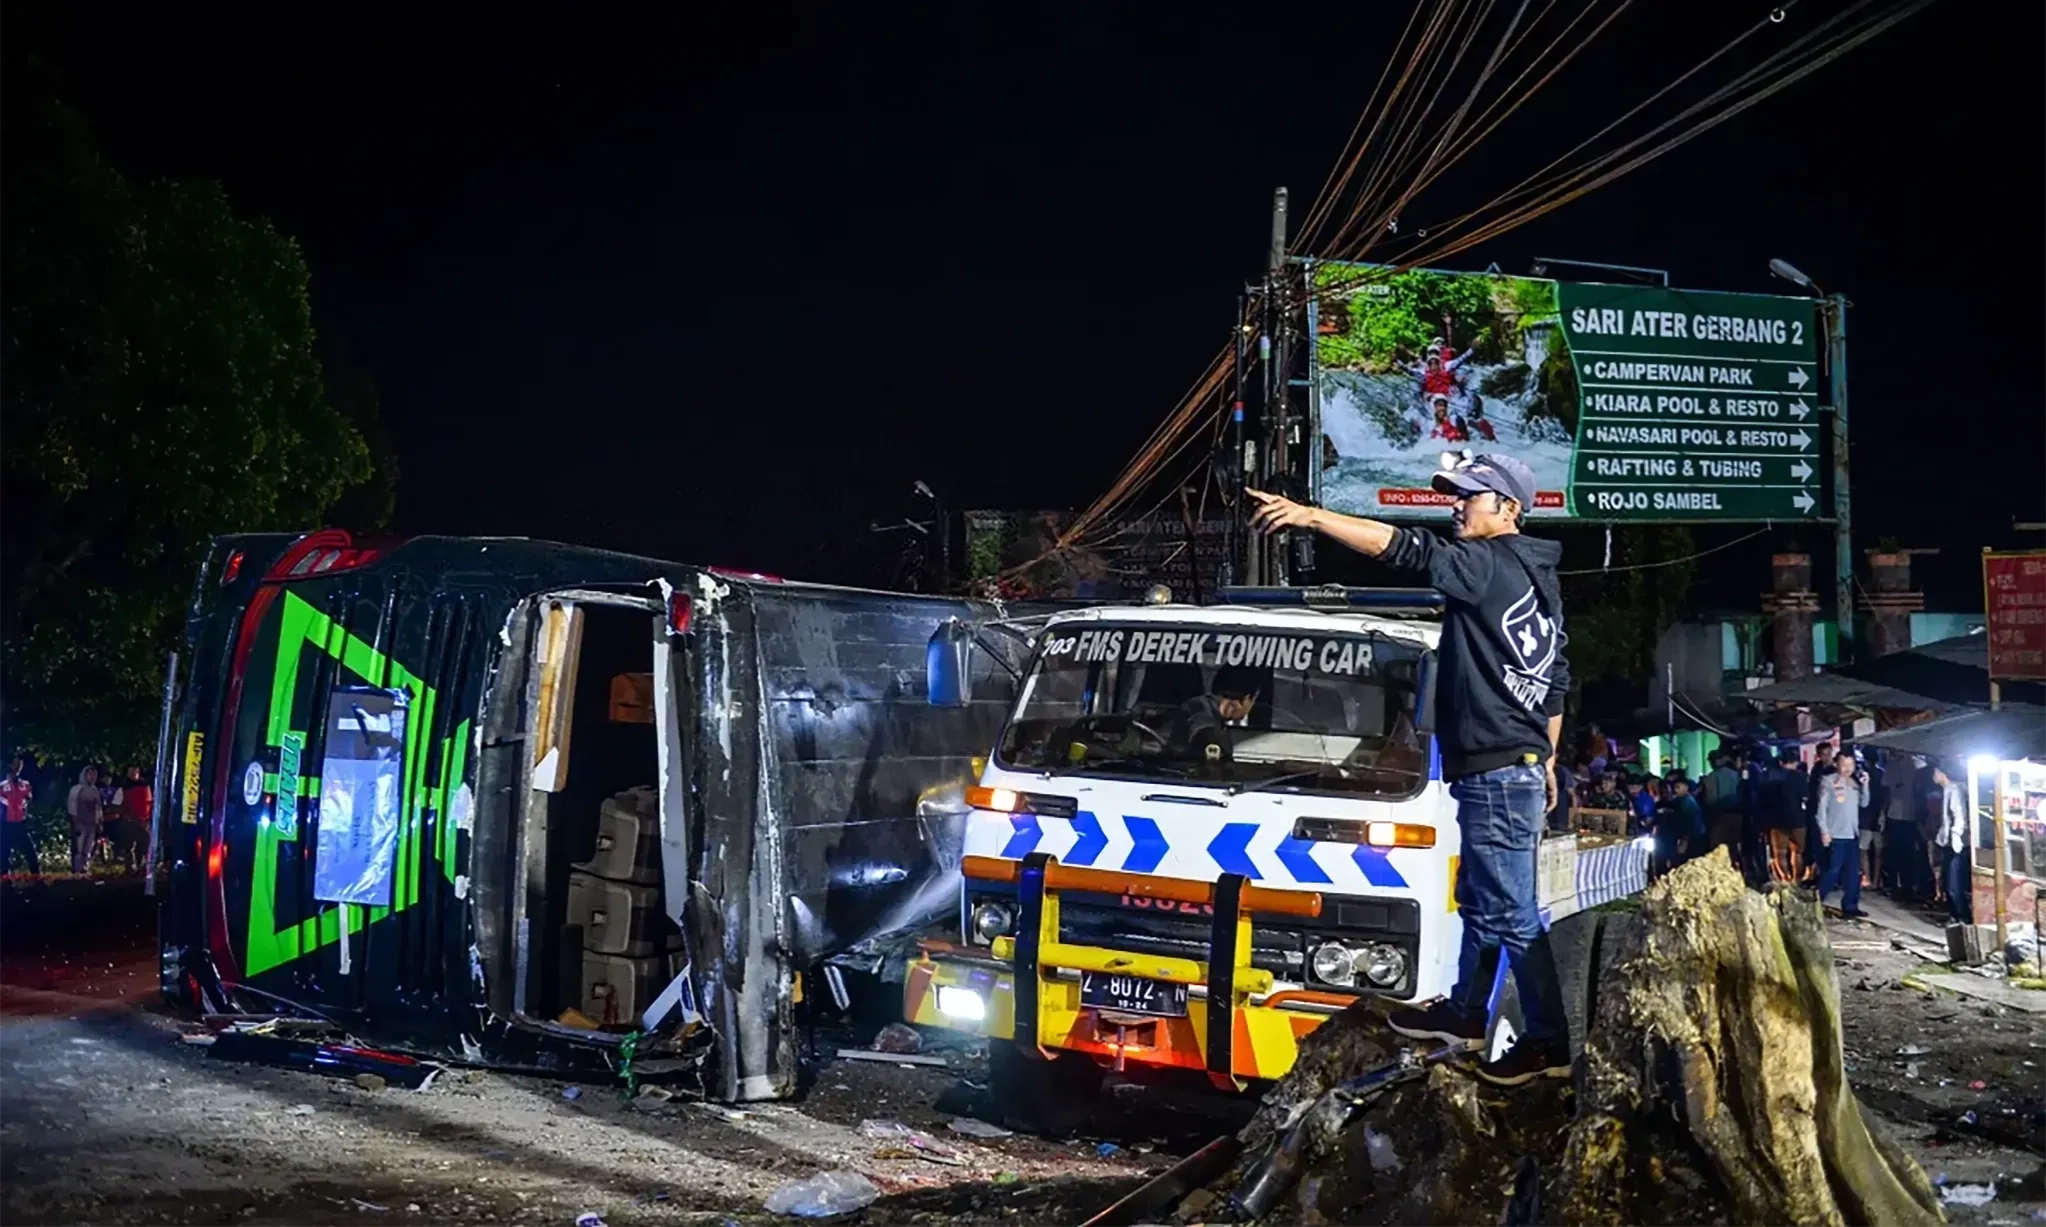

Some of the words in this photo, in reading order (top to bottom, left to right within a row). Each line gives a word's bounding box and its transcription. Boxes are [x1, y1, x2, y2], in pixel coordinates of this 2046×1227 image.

[1571, 307, 1624, 335] SARI
[1631, 310, 1688, 338] ATER
[1692, 314, 1786, 344] GERBANG
[1791, 321, 1804, 345] 2
[1594, 361, 1705, 384] CAMPERVAN
[1709, 366, 1753, 385] PARK
[1595, 394, 1652, 413] KIARA
[1657, 396, 1704, 415] POOL
[1708, 398, 1721, 415] &
[1726, 398, 1779, 417] RESTO
[1596, 426, 1677, 444] NAVASARI
[1681, 428, 1722, 445] POOL
[1725, 429, 1737, 445] &
[1741, 430, 1788, 447] RESTO
[1597, 458, 1677, 477] RAFTING
[1682, 460, 1695, 477] &
[1699, 460, 1762, 478] TUBING
[1598, 492, 1648, 510] ROJO
[1653, 492, 1722, 510] SAMBEL
[1074, 631, 1121, 662] FMS
[1125, 631, 1206, 664] DEREK
[1214, 634, 1313, 670] TOWING
[1319, 641, 1376, 676] CAR
[276, 733, 301, 835] TRANS
[1110, 976, 1154, 1000] 8072
